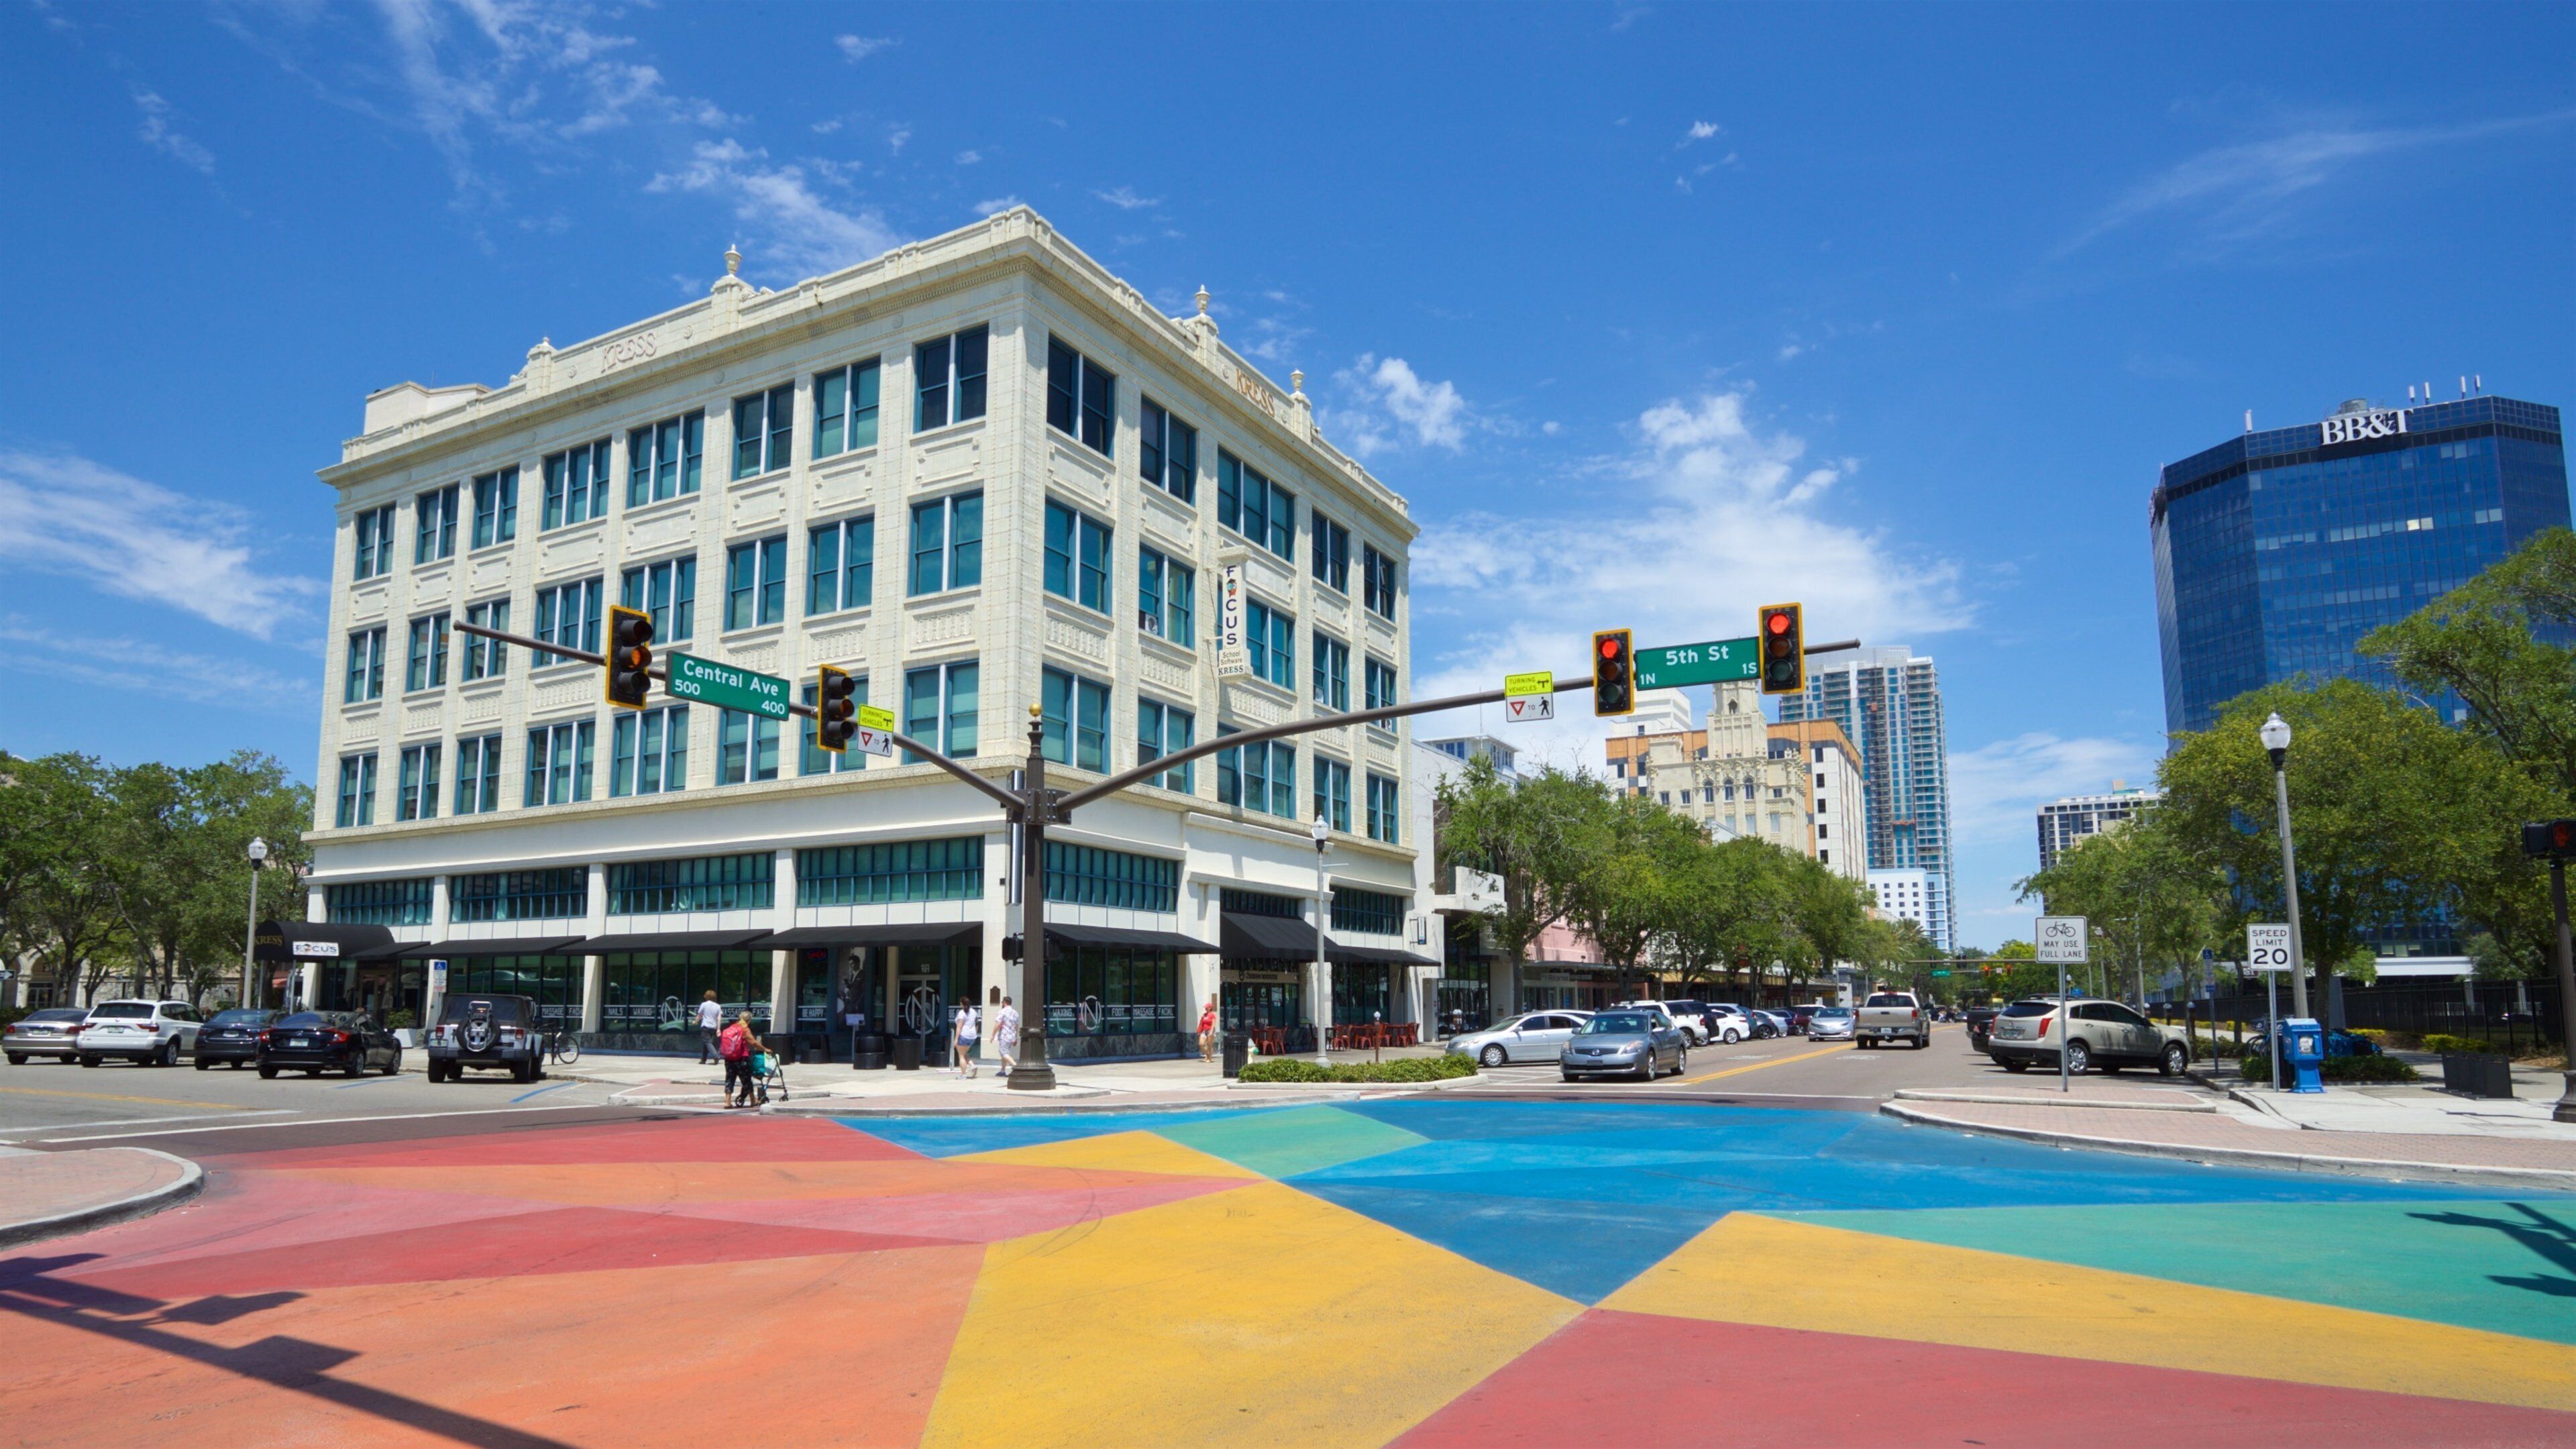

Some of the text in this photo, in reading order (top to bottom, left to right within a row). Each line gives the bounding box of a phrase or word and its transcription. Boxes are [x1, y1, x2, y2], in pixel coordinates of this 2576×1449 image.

[601, 332, 657, 374] KRESS
[1236, 368, 1275, 417] KRESS
[2320, 408, 2414, 445] BB&T
[1222, 650, 1240, 659] School
[1666, 645, 1729, 665] 5th St
[1220, 657, 1242, 665] Software
[1218, 665, 1244, 676] KRESS
[1742, 662, 1758, 674] 1S
[684, 659, 779, 696] Central Ave
[1640, 673, 1656, 686] 1N
[674, 679, 700, 695] 500
[1508, 685, 1538, 693] VEHICLES
[761, 700, 785, 715] 400
[863, 708, 883, 718] TURNING
[861, 717, 883, 727] VEHICLES
[2253, 948, 2288, 965] 20
[542, 1008, 564, 1016] MASSAGE
[608, 1008, 653, 1016] NAILS WAXING
[753, 1008, 771, 1016] FACIAL
[802, 1008, 824, 1018] BE HAPPY
[1052, 1008, 1072, 1017] WAXING
[1111, 1007, 1174, 1016] FOOT MASSAGE FACIAL
